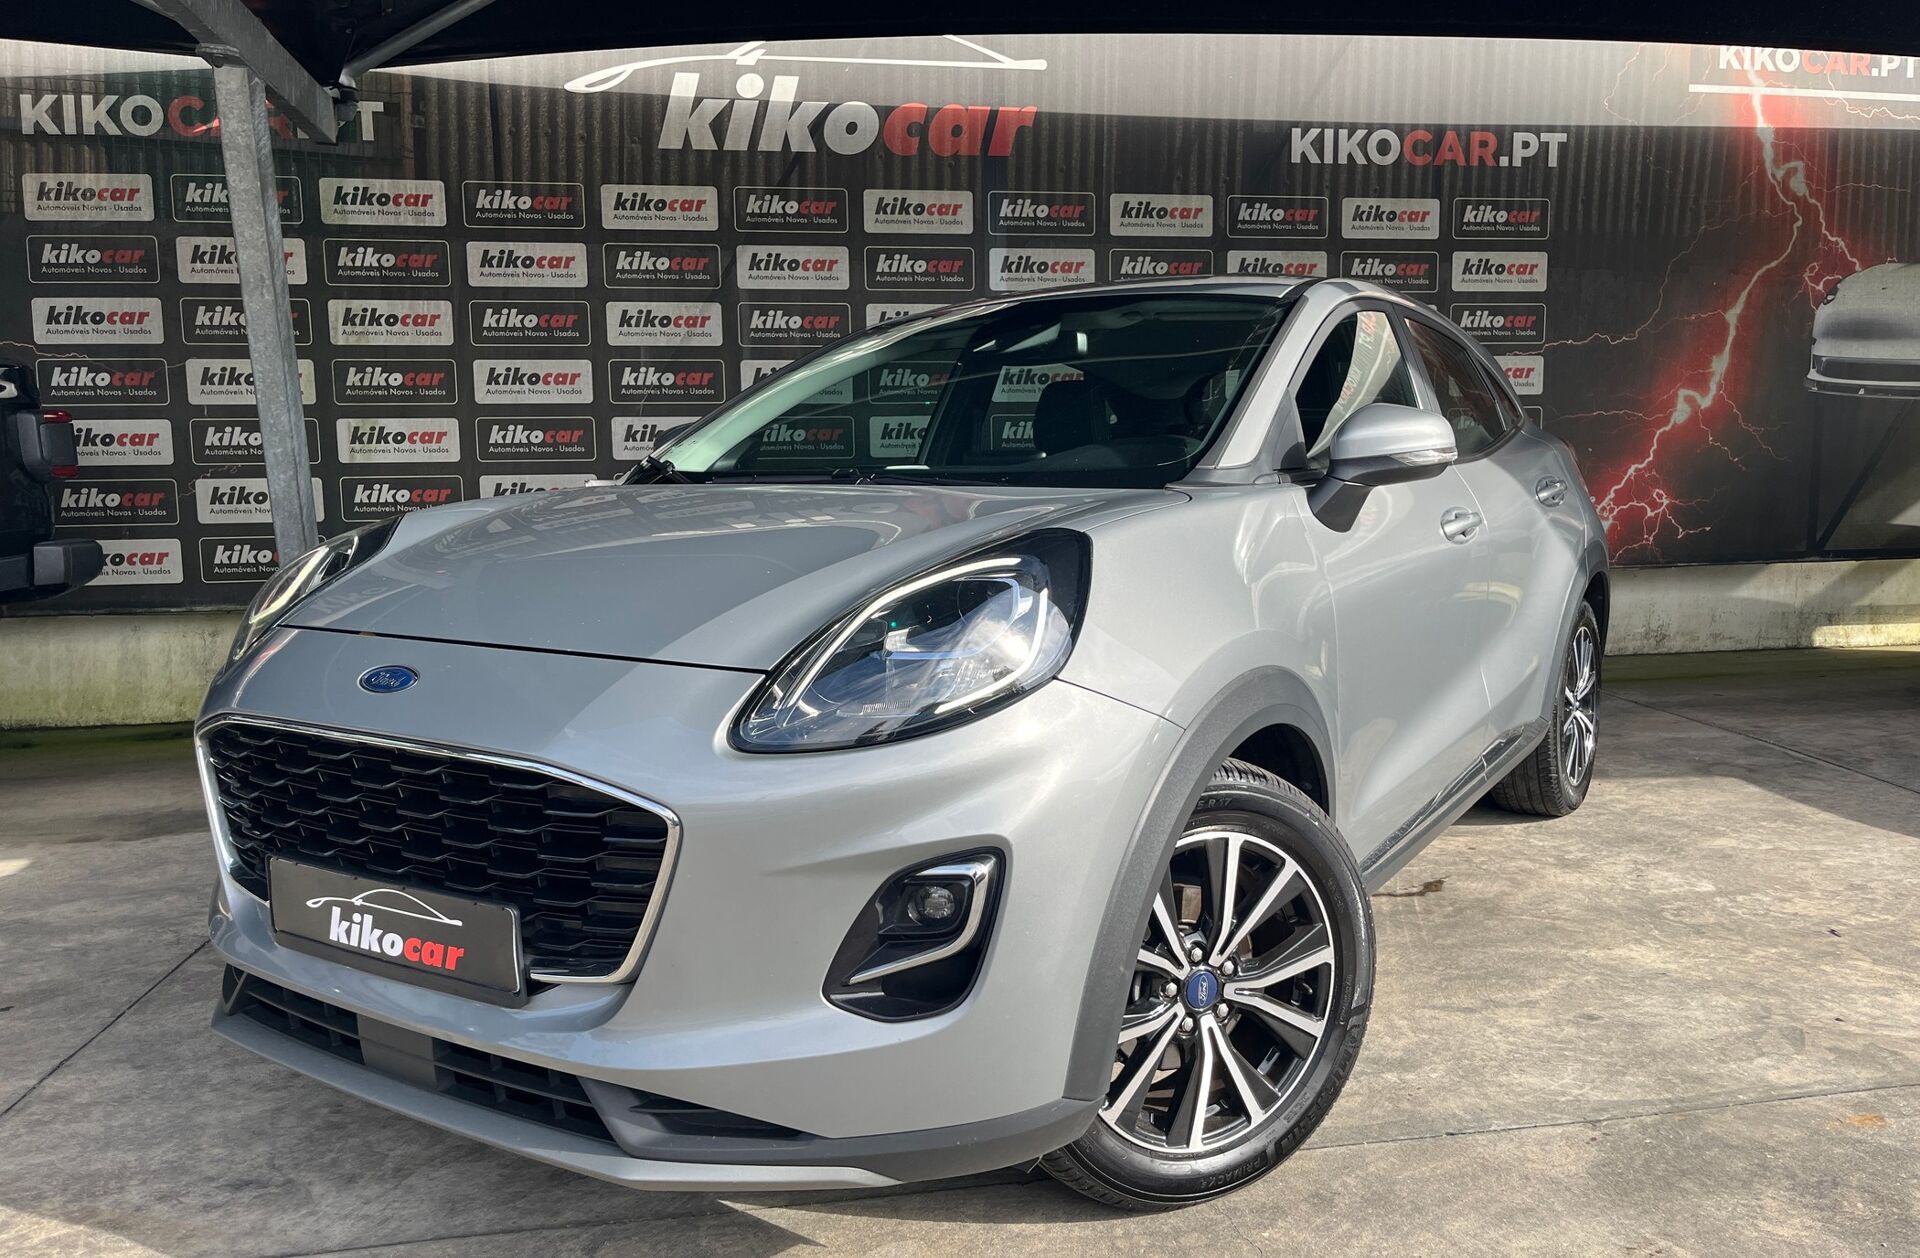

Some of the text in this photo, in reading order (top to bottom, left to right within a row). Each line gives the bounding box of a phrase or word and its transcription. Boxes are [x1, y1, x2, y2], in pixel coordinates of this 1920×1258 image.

[657, 71, 1038, 157] kikocar
[1290, 127, 1567, 167] KIKOCAR.PT
[36, 180, 141, 203] kikocar
[333, 186, 434, 207] kikocar
[476, 189, 573, 210] kikocar
[82, 203, 107, 212] Novos
[114, 203, 142, 213] Usados
[613, 192, 707, 212] kikocar
[746, 194, 836, 214] kikocar
[874, 196, 963, 216] kikocar
[999, 198, 1084, 218] kikocar
[1120, 200, 1203, 220] kikocar
[378, 208, 401, 216] Novos
[408, 209, 435, 217] Usados
[517, 211, 542, 219] Novos
[548, 211, 574, 220] Usados
[682, 214, 708, 222] Usados
[784, 216, 808, 224] Novos
[813, 216, 838, 224] Usados
[1238, 202, 1318, 222] kikocar
[1352, 204, 1430, 223] kikocar
[1462, 205, 1540, 223] kikocar
[41, 243, 146, 264] kikocar
[337, 246, 438, 267] kikocar
[479, 249, 576, 269] kikocar
[616, 250, 709, 270] kikocar
[748, 252, 839, 272] kikocar
[87, 266, 112, 274] Novos
[118, 265, 147, 274] Usados
[876, 254, 963, 273] kikocar
[1000, 255, 1085, 275] kikocar
[1120, 256, 1202, 275] kikocar
[1238, 257, 1318, 276] kikocar
[1350, 257, 1429, 276] kikocar
[1462, 258, 1538, 276] kikocar
[382, 269, 406, 277] Novos
[412, 269, 439, 278] Usados
[522, 271, 545, 279] Novos
[550, 271, 576, 279] Usados
[657, 272, 679, 280] Novos
[685, 272, 710, 280] Usados
[940, 274, 964, 282] Usados
[46, 305, 151, 325] kikocar
[342, 307, 441, 327] kikocar
[482, 308, 578, 328] kikocar
[618, 309, 711, 329] kikocar
[750, 310, 840, 329] kikocar
[1460, 310, 1537, 328] kikocar
[92, 327, 116, 335] Novos
[123, 327, 152, 335] Usados
[386, 329, 409, 337] Novos
[416, 329, 442, 337] Usados
[524, 329, 548, 337] Novos
[554, 329, 580, 337] Usados
[659, 330, 682, 338] Novos
[686, 330, 712, 338] Usados
[816, 330, 840, 338] Usados
[50, 366, 156, 386] kikocar
[346, 366, 445, 386] kikocar
[486, 366, 581, 386] kikocar
[621, 366, 714, 386] kikocar
[97, 388, 122, 396] Novos
[128, 388, 157, 396] Usados
[390, 388, 413, 396] Novos
[419, 387, 446, 396] Usados
[556, 387, 582, 395] Usados
[662, 387, 684, 395] Novos
[690, 387, 714, 395] Usados
[349, 426, 448, 446] kikocar
[488, 424, 584, 444] kikocar
[422, 446, 449, 454] Usados
[531, 445, 554, 453] Novos
[559, 444, 585, 452] Usados
[61, 488, 166, 508] kikocar
[354, 483, 451, 503] kikocar
[138, 508, 167, 516] Usados
[329, 905, 465, 971] kikocar
